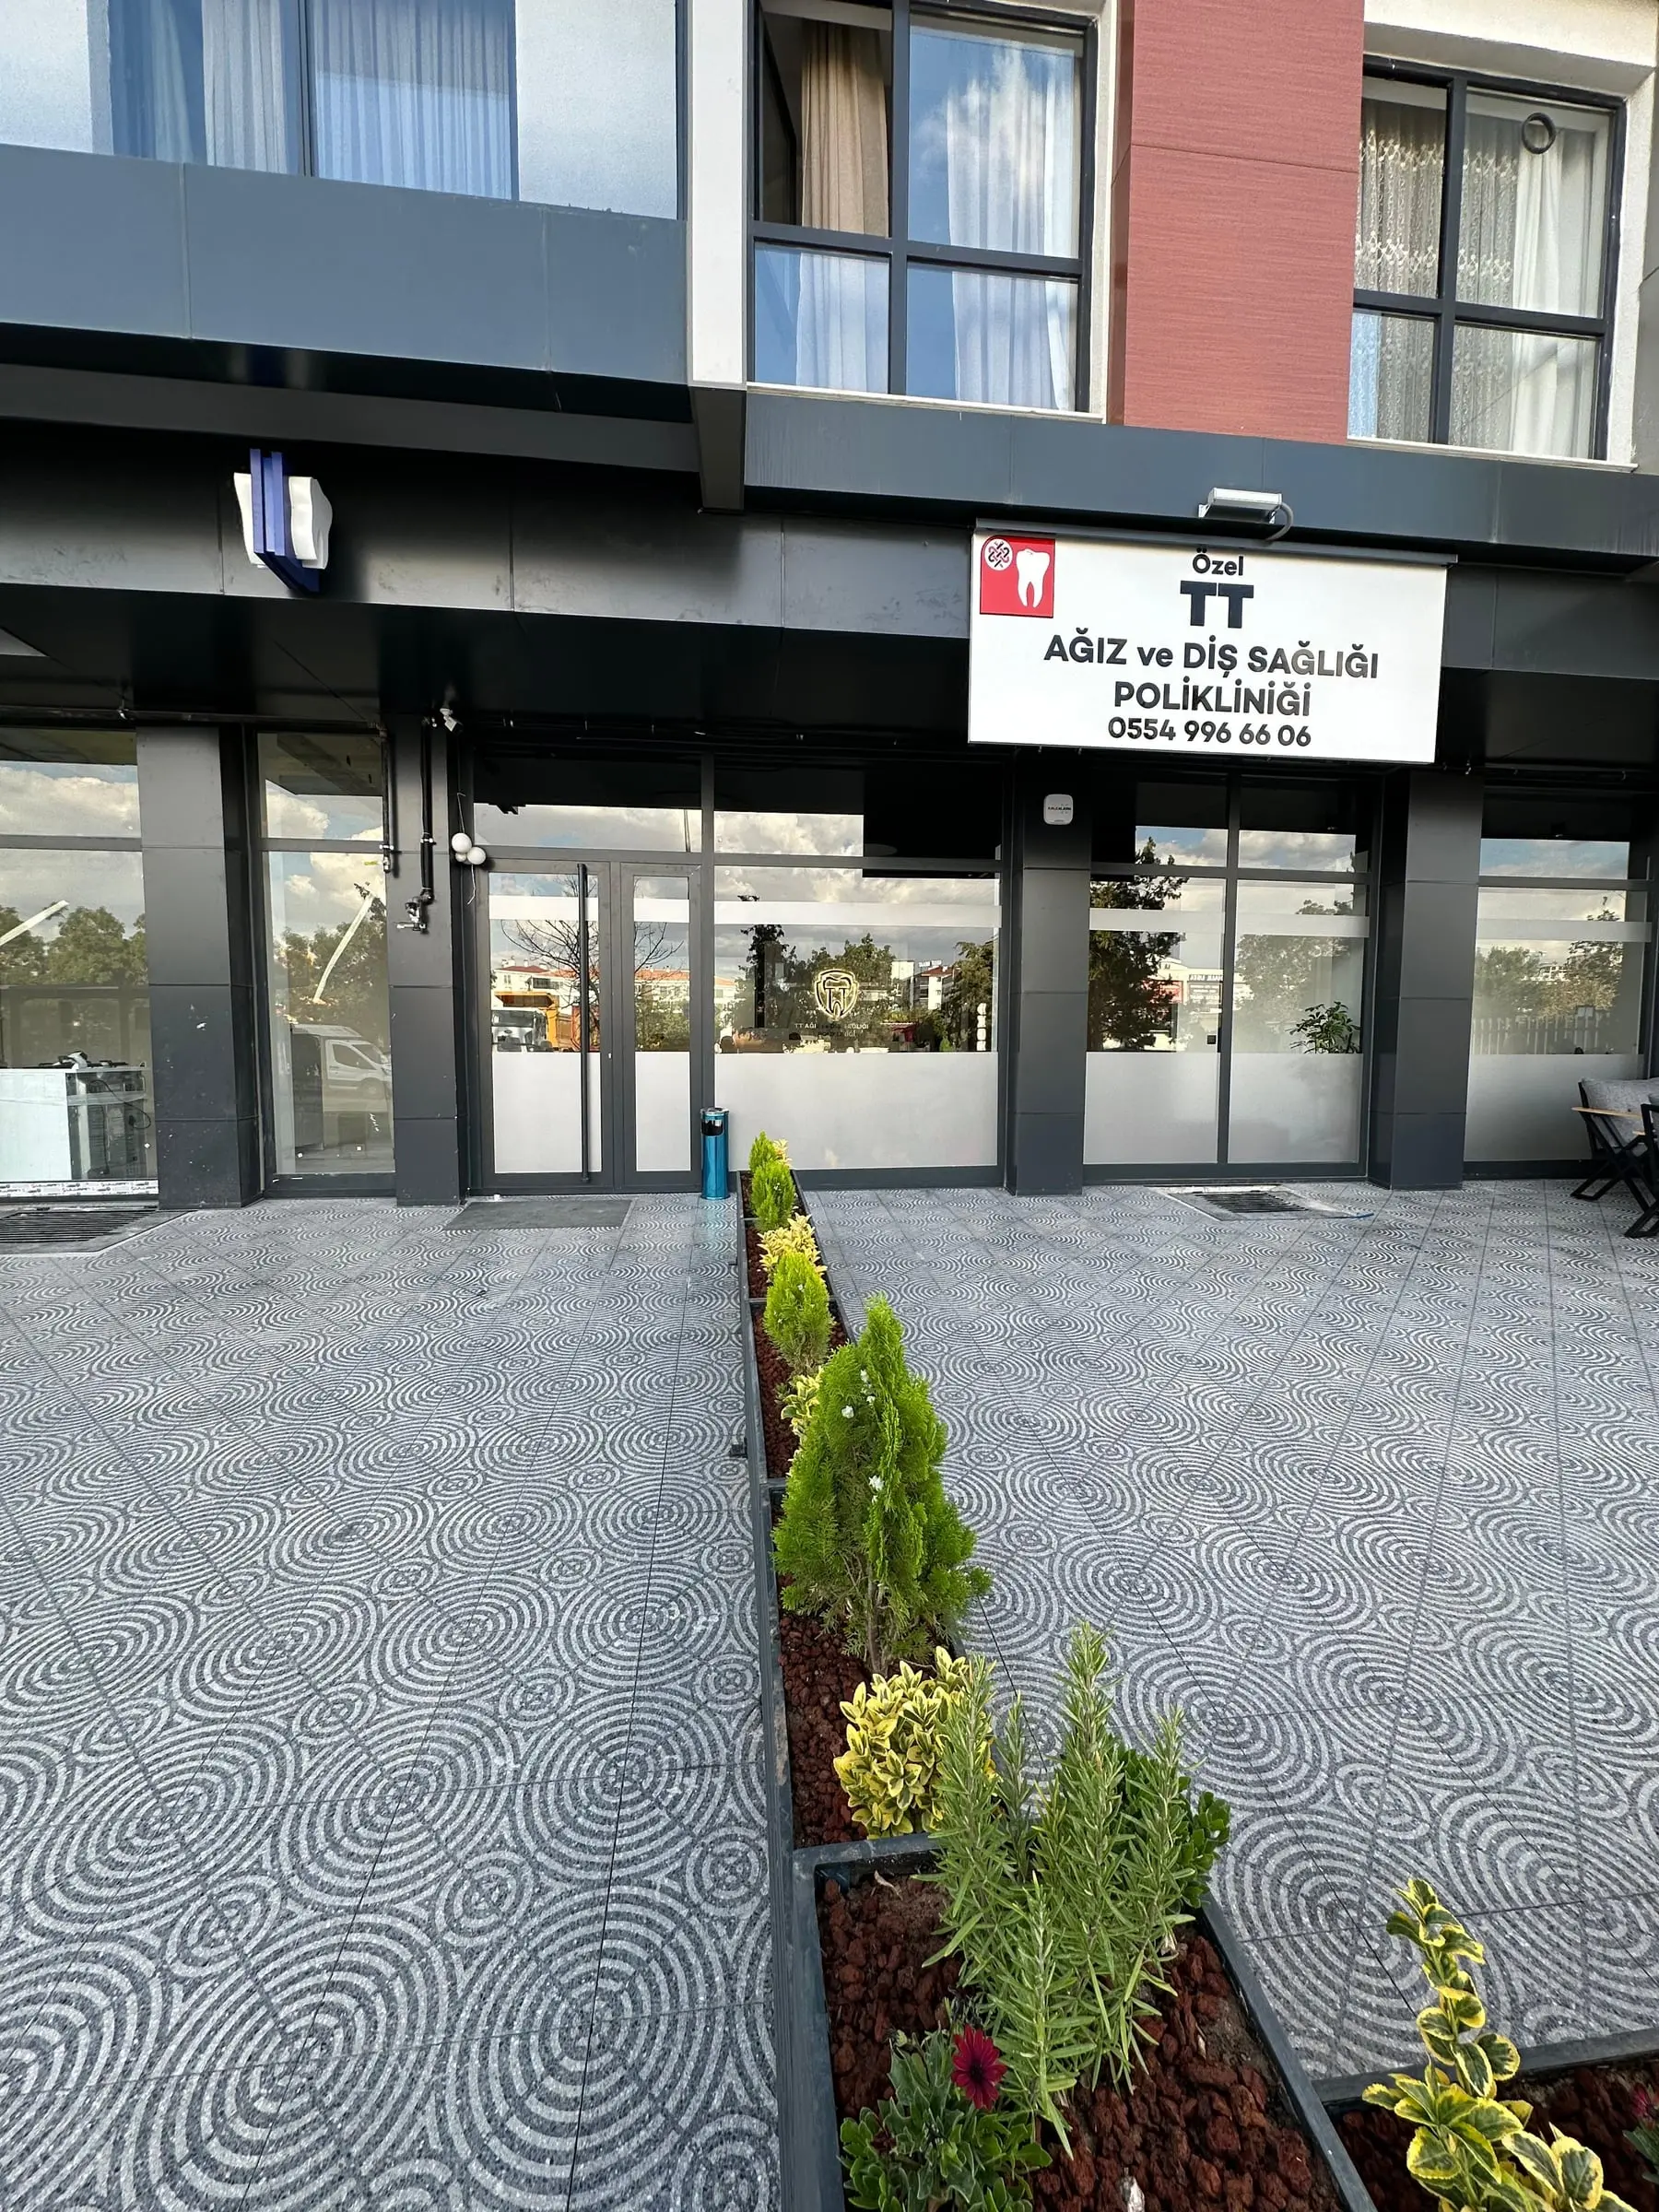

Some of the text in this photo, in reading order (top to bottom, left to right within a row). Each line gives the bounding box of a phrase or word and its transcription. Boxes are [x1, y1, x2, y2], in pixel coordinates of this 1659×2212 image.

[1192, 547, 1244, 577] Özel
[1180, 580, 1254, 629] TT
[1043, 627, 1379, 679] AĞIZ ve DİŞ SAĞLIĞI
[1114, 676, 1312, 717] POLİKLİNİĞİ
[1108, 716, 1312, 747] 0554 996 66 06
